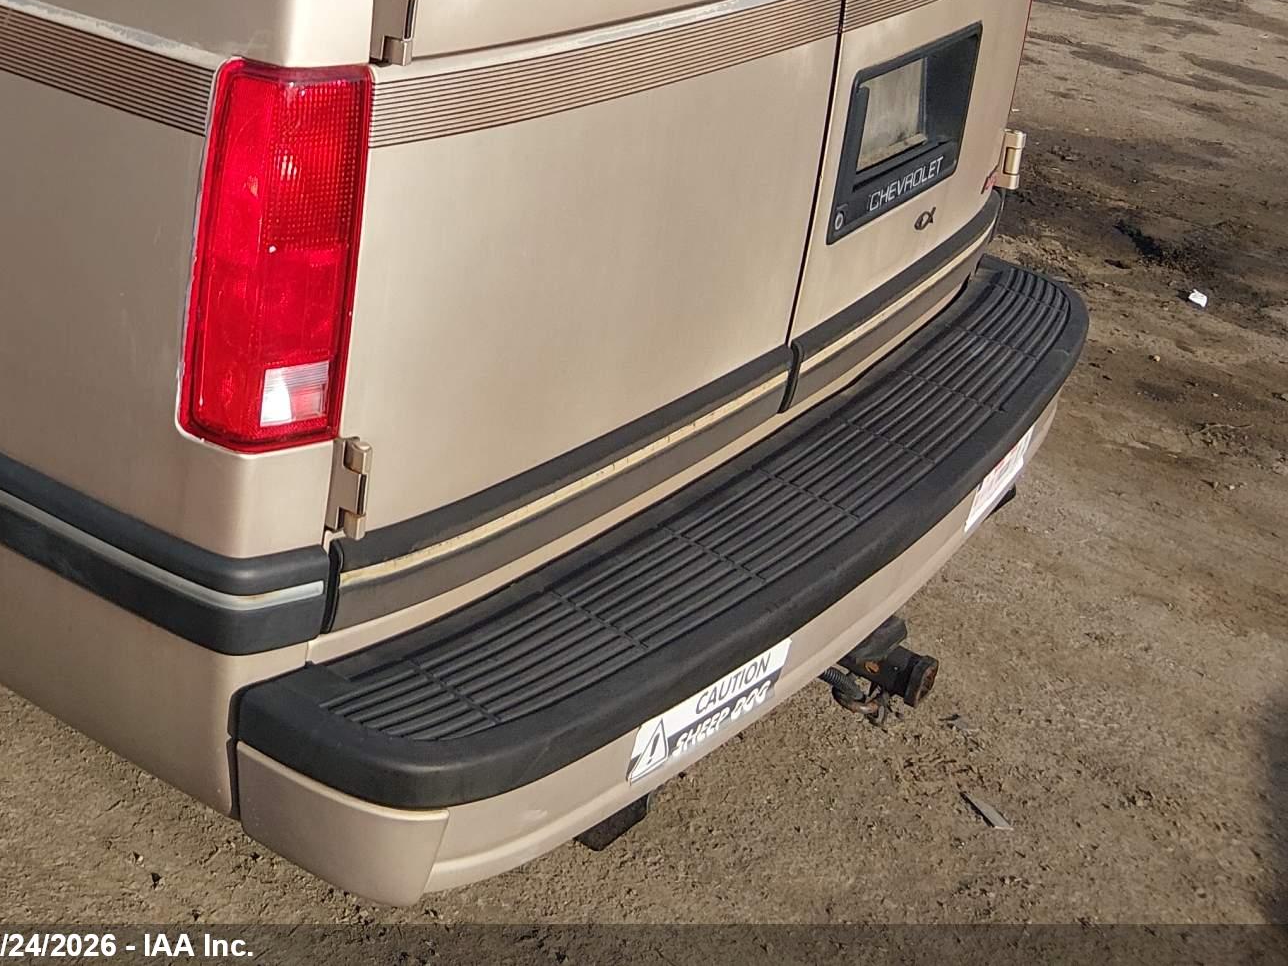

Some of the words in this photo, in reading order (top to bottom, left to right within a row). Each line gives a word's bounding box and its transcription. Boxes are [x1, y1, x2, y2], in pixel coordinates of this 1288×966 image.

[868, 155, 944, 212] CHEVROLET
[695, 653, 771, 715] CAUTION
[673, 706, 730, 754] SHEEP
[730, 680, 772, 718] DOG
